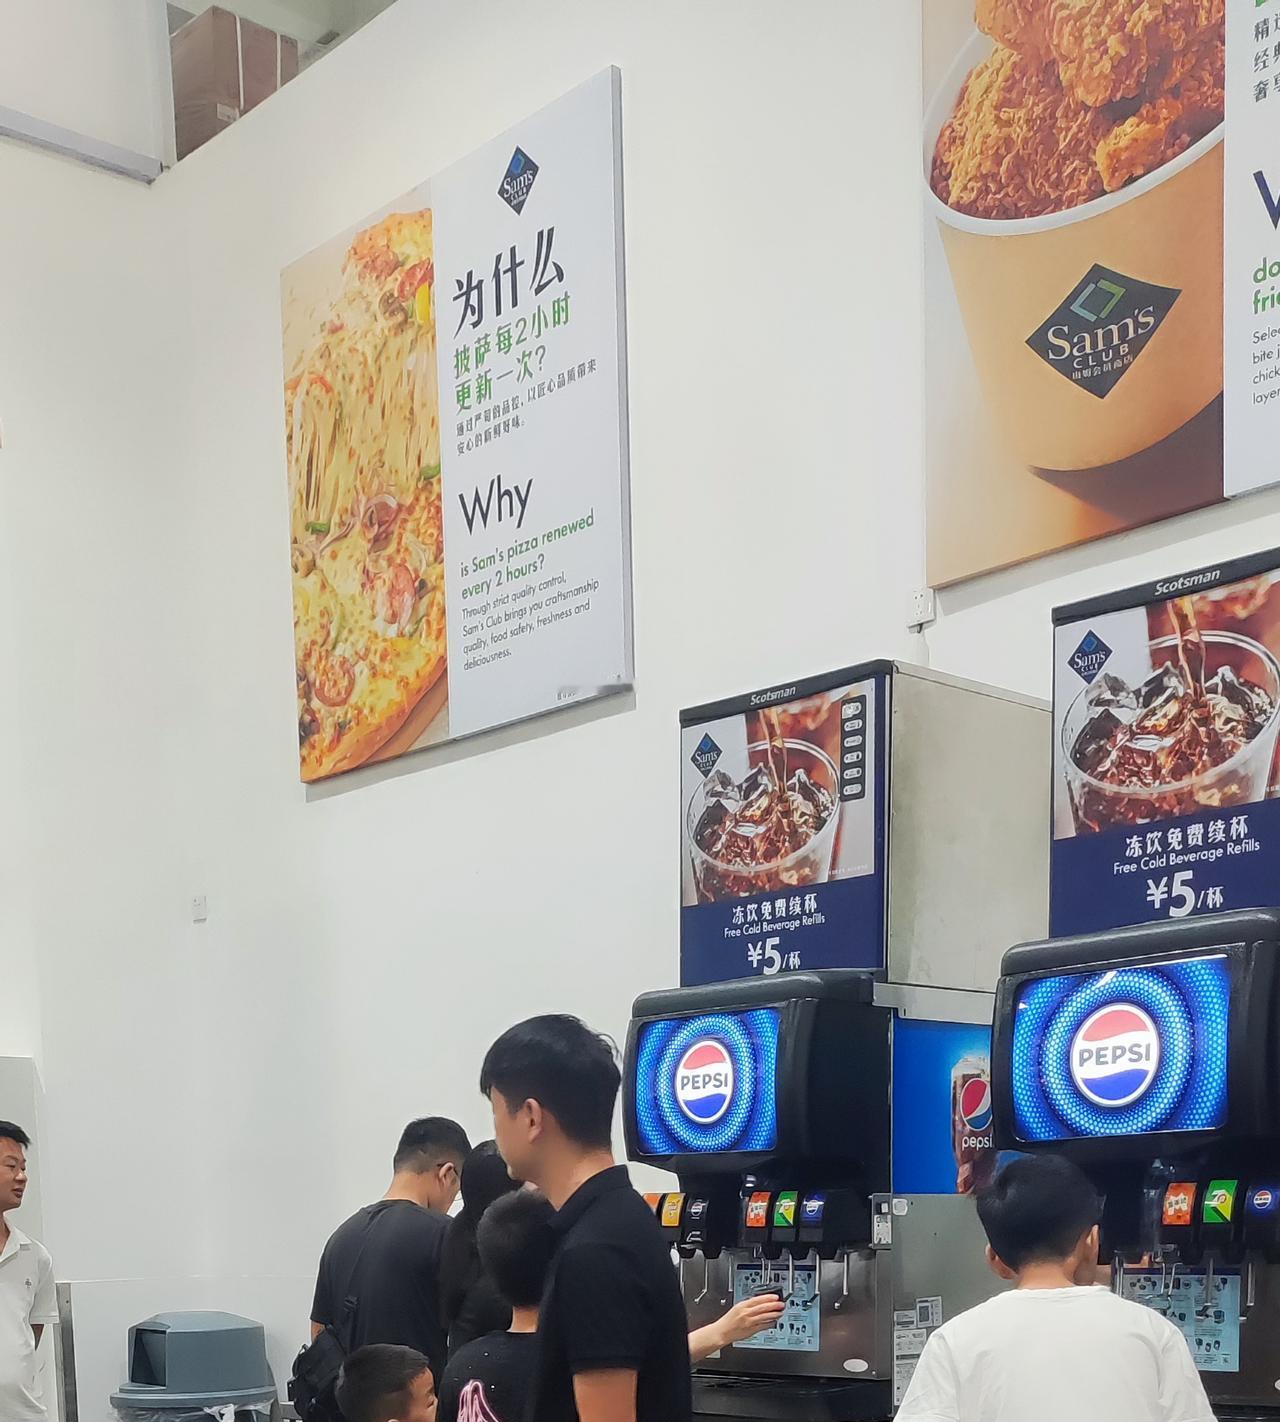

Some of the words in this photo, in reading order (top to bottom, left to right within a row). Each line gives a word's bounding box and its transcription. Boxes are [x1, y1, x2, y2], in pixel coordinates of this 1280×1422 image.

[503, 170, 533, 198] Sam's
[452, 226, 565, 339] 为什么
[453, 291, 570, 379] 披萨每2小时
[1047, 305, 1155, 360] Sam's
[1073, 343, 1129, 369] CLUB
[1253, 350, 1273, 364] bite
[458, 474, 533, 536] Why
[460, 562, 469, 578] is
[472, 547, 504, 573] Sam's
[507, 539, 538, 563] pizza
[542, 506, 594, 545] renewed
[462, 579, 491, 600] every
[495, 570, 503, 587] 2
[506, 553, 545, 582] hours?
[1154, 569, 1221, 595] Scotsman
[462, 602, 491, 619] Through
[493, 594, 509, 609] strict
[511, 584, 536, 603] quality
[538, 571, 567, 592] control,
[463, 620, 484, 637] Sam's
[486, 613, 502, 628] Club
[504, 607, 527, 622] brings
[529, 601, 543, 616] you
[545, 578, 599, 607] craftsmanship
[491, 628, 508, 644] food
[537, 607, 572, 628] freshness
[574, 598, 590, 614] and
[463, 648, 512, 671] deliciousness.
[1073, 650, 1106, 669] Sam's
[750, 686, 796, 705] Scotsman
[1125, 814, 1248, 858] 冻饮免费续杯
[1113, 862, 1137, 875] Free
[1140, 854, 1166, 870] Cold
[1169, 848, 1223, 865] Beverage
[1227, 838, 1260, 855] Refills
[724, 928, 741, 938] Free
[743, 922, 761, 935] Cold
[763, 919, 800, 932] Beverage
[802, 912, 825, 926] Refills
[732, 893, 817, 925] 冻饮免费续杯
[1079, 1042, 1151, 1067] PEPSI
[681, 1072, 728, 1090] PEPSI
[962, 1133, 993, 1151] pepsi
